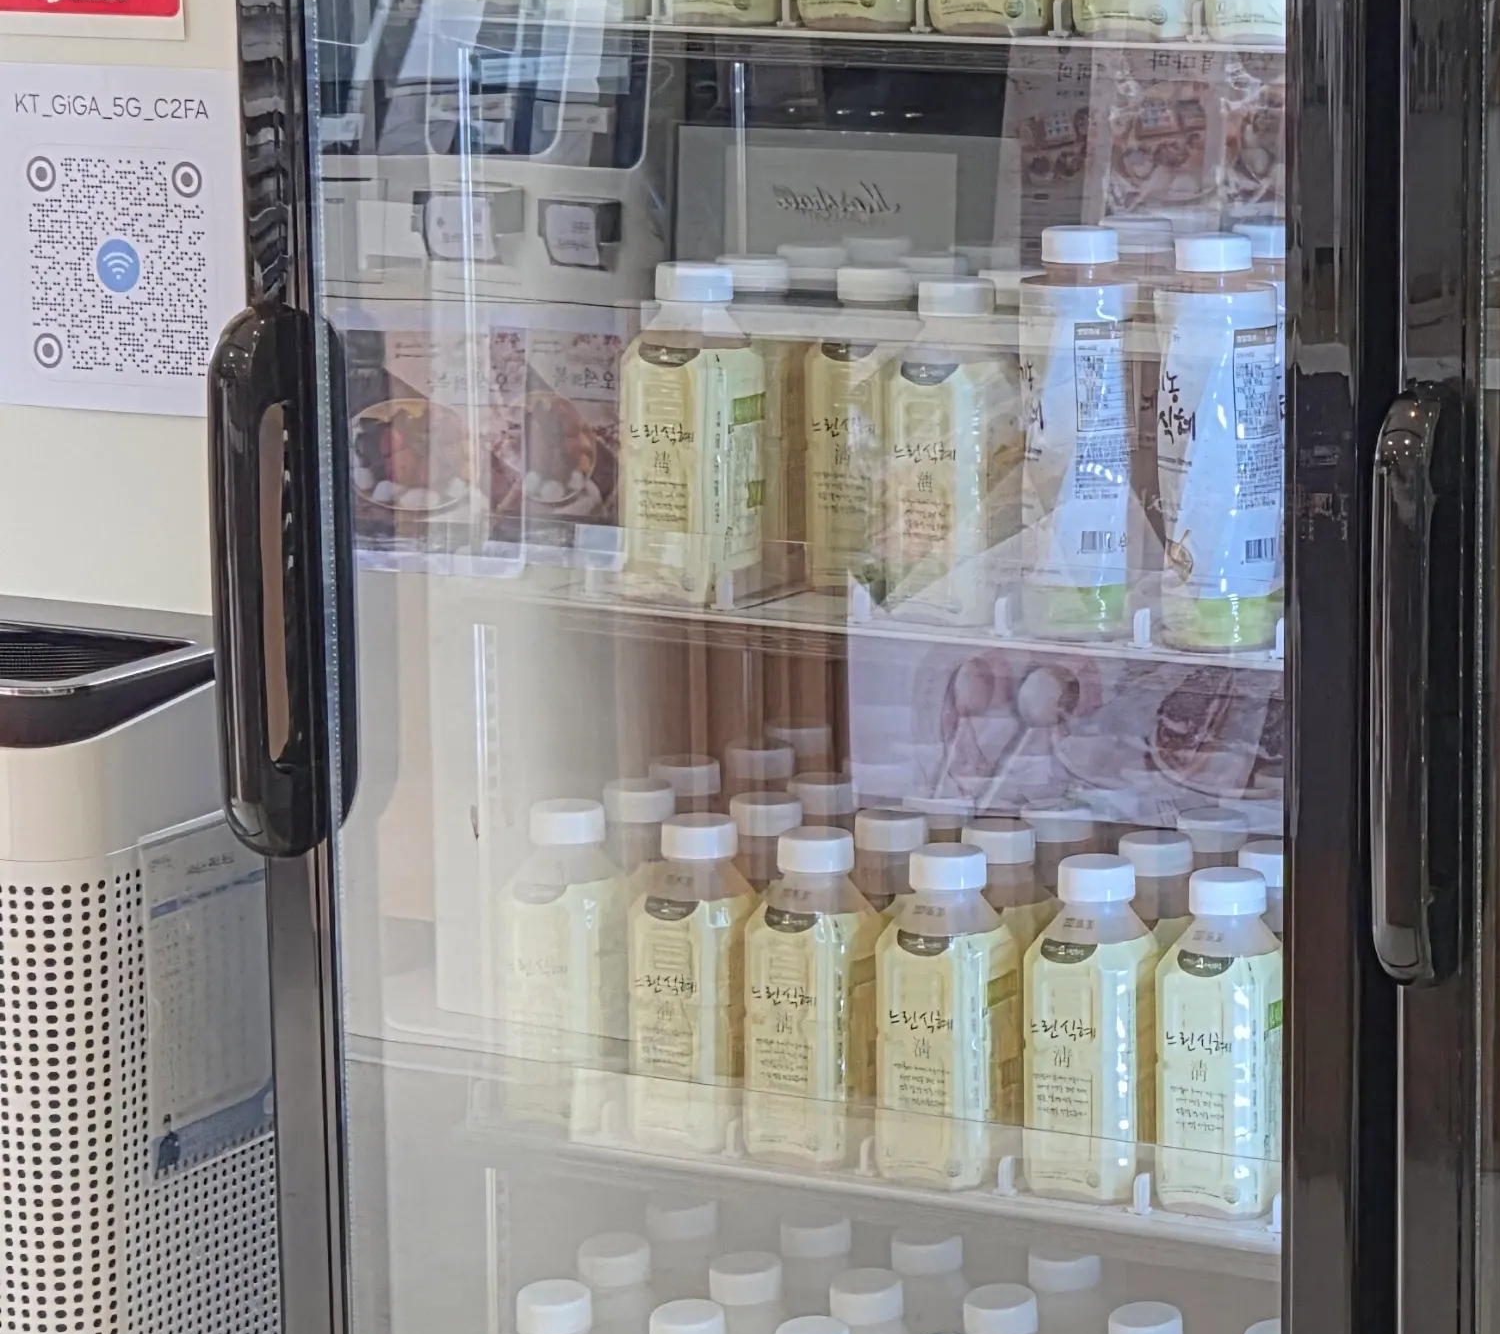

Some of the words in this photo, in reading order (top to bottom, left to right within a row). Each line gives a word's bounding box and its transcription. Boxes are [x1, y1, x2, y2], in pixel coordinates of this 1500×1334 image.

[14, 93, 209, 121] KT_GiGA_5G_C2FA
[889, 1010, 954, 1034] 느린식혜
[1030, 1017, 1097, 1043] 느린식혜
[1165, 1030, 1233, 1055] 느린식혜
